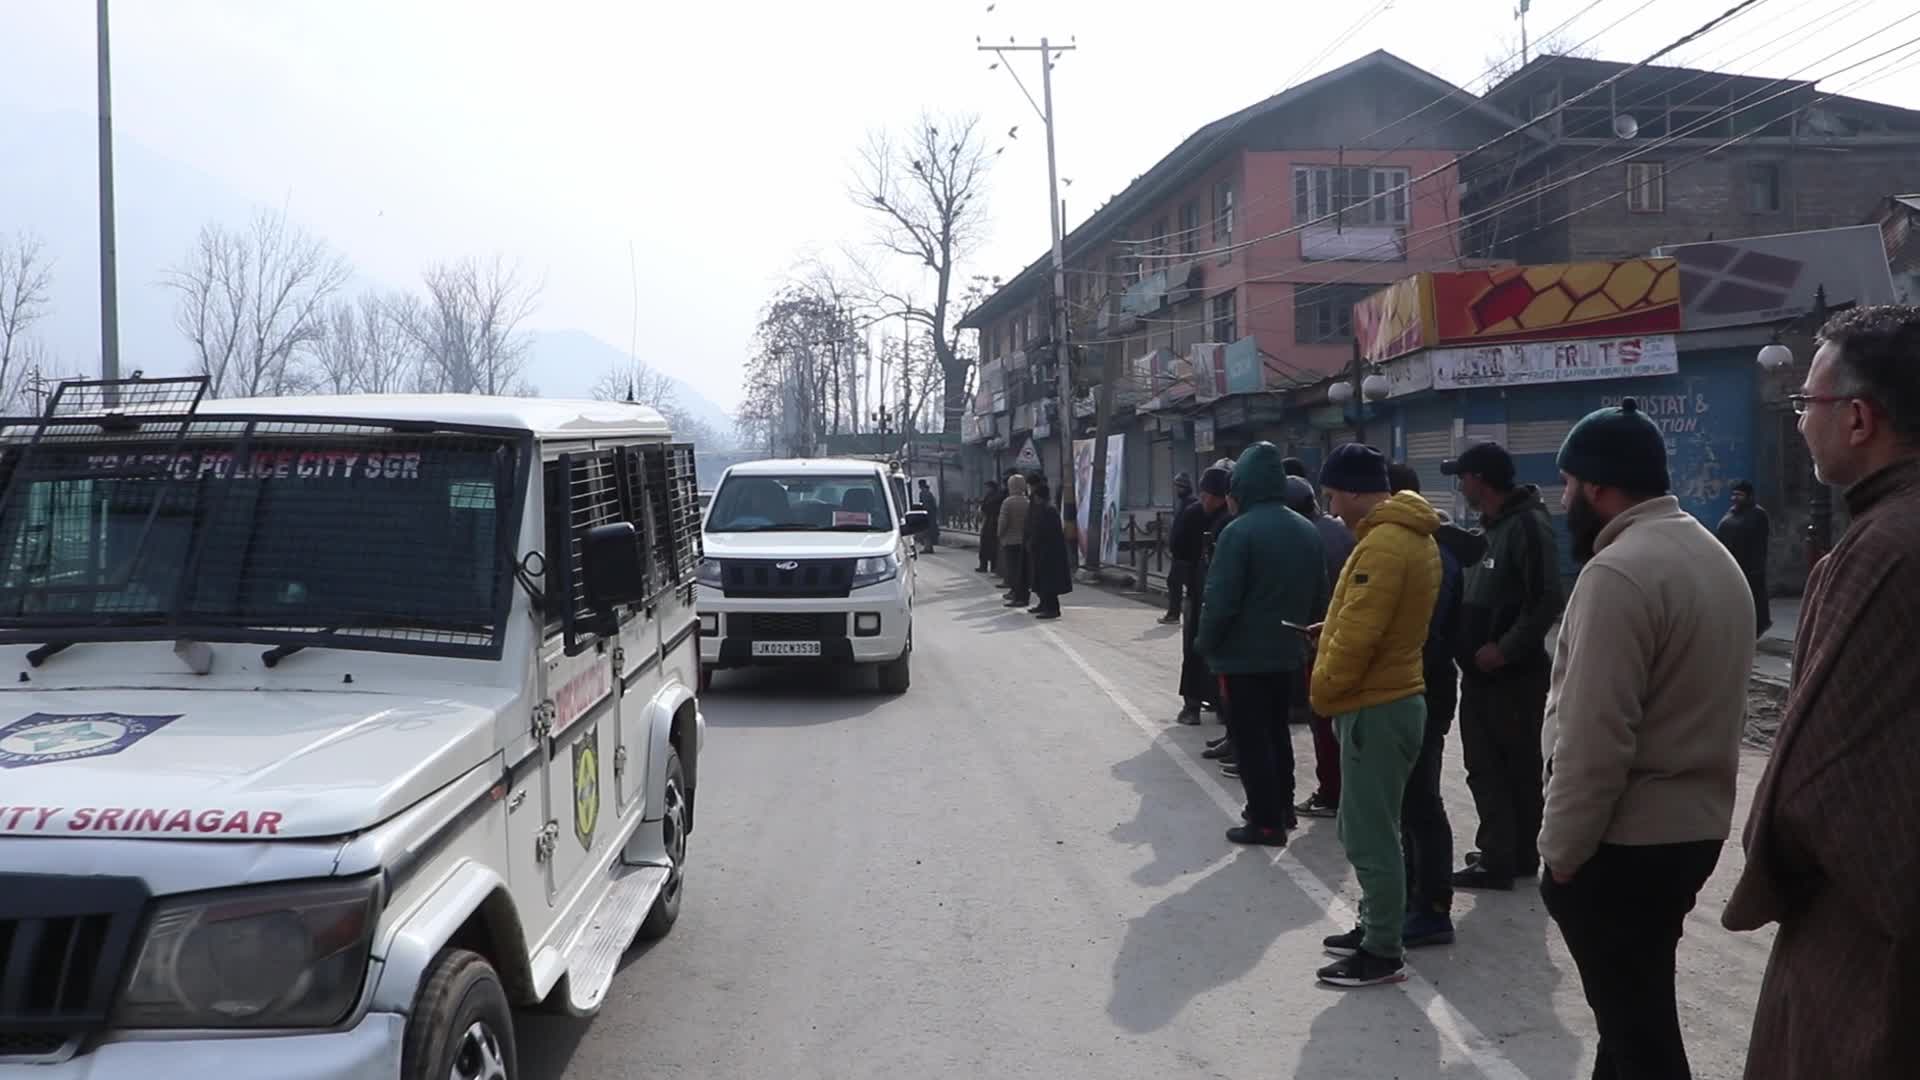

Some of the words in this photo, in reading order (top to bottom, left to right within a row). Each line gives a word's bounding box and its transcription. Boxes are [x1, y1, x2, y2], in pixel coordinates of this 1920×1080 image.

[196, 452, 289, 480] POLICE
[296, 452, 360, 479] CITY
[364, 451, 421, 479] SGR
[67, 807, 282, 834] SRINAGAR
